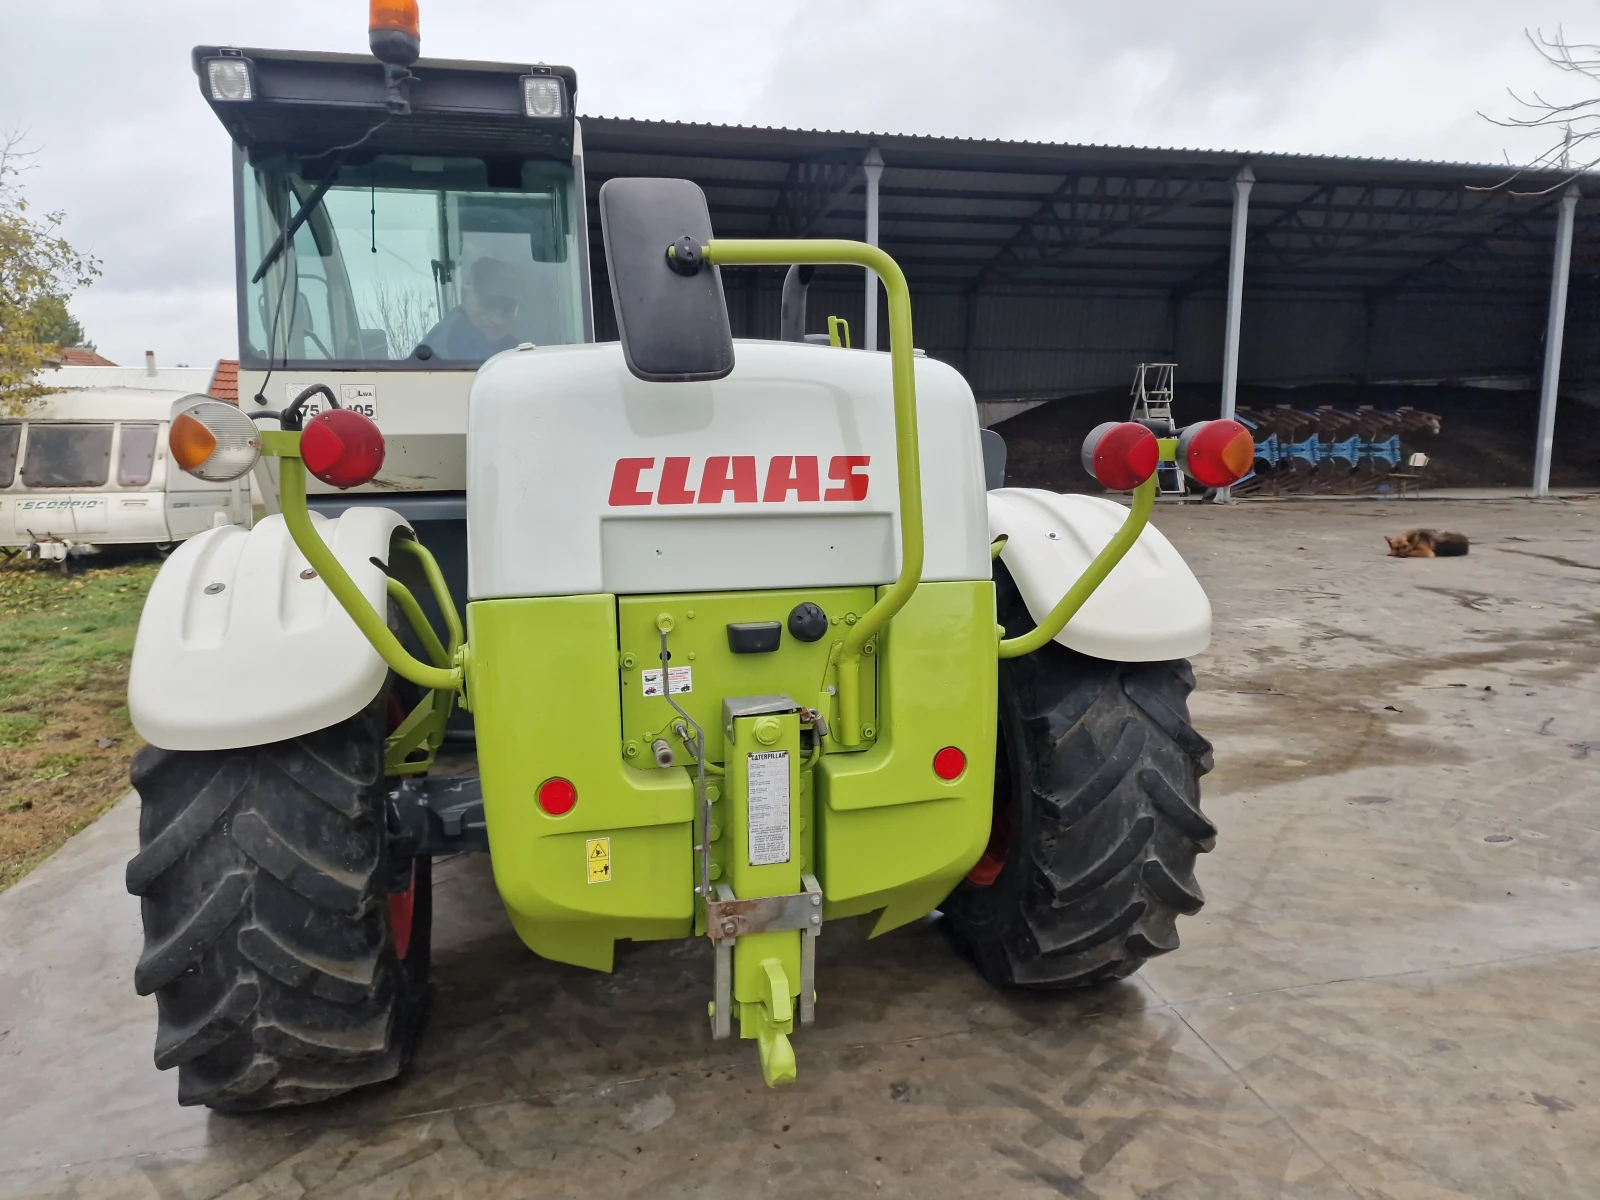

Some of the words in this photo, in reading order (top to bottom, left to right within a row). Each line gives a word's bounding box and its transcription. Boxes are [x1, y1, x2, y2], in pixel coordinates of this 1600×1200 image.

[300, 404, 320, 417] 75
[607, 455, 871, 507] CLAAS
[22, 500, 99, 510] SCORPIO
[750, 752, 786, 761] CATERPILLAR
